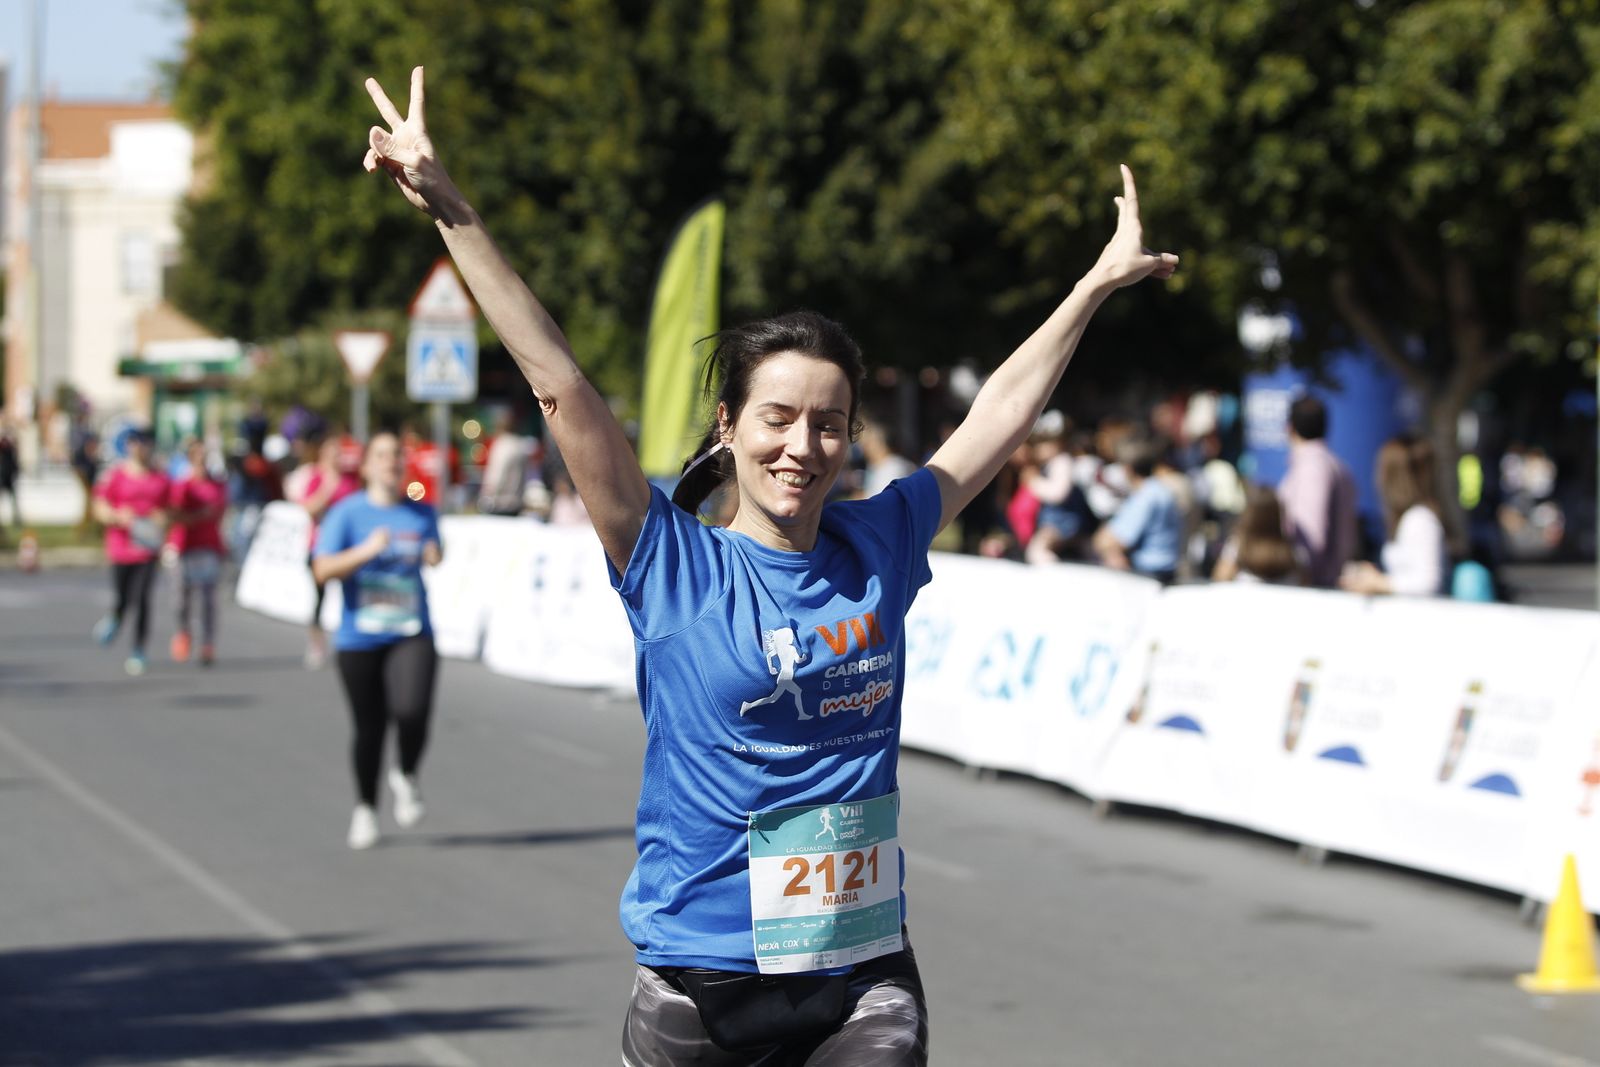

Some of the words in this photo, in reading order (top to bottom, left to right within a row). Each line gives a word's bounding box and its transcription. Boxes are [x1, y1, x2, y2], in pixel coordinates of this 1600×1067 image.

[824, 651, 893, 679] CARRERA
[820, 679, 893, 718] mujer
[733, 743, 748, 753] LA
[751, 744, 806, 754] IGUALDAD
[809, 742, 822, 751] ES
[796, 844, 833, 852] IGUALDAD
[782, 845, 879, 897] 2121
[758, 941, 780, 952] NEXA
